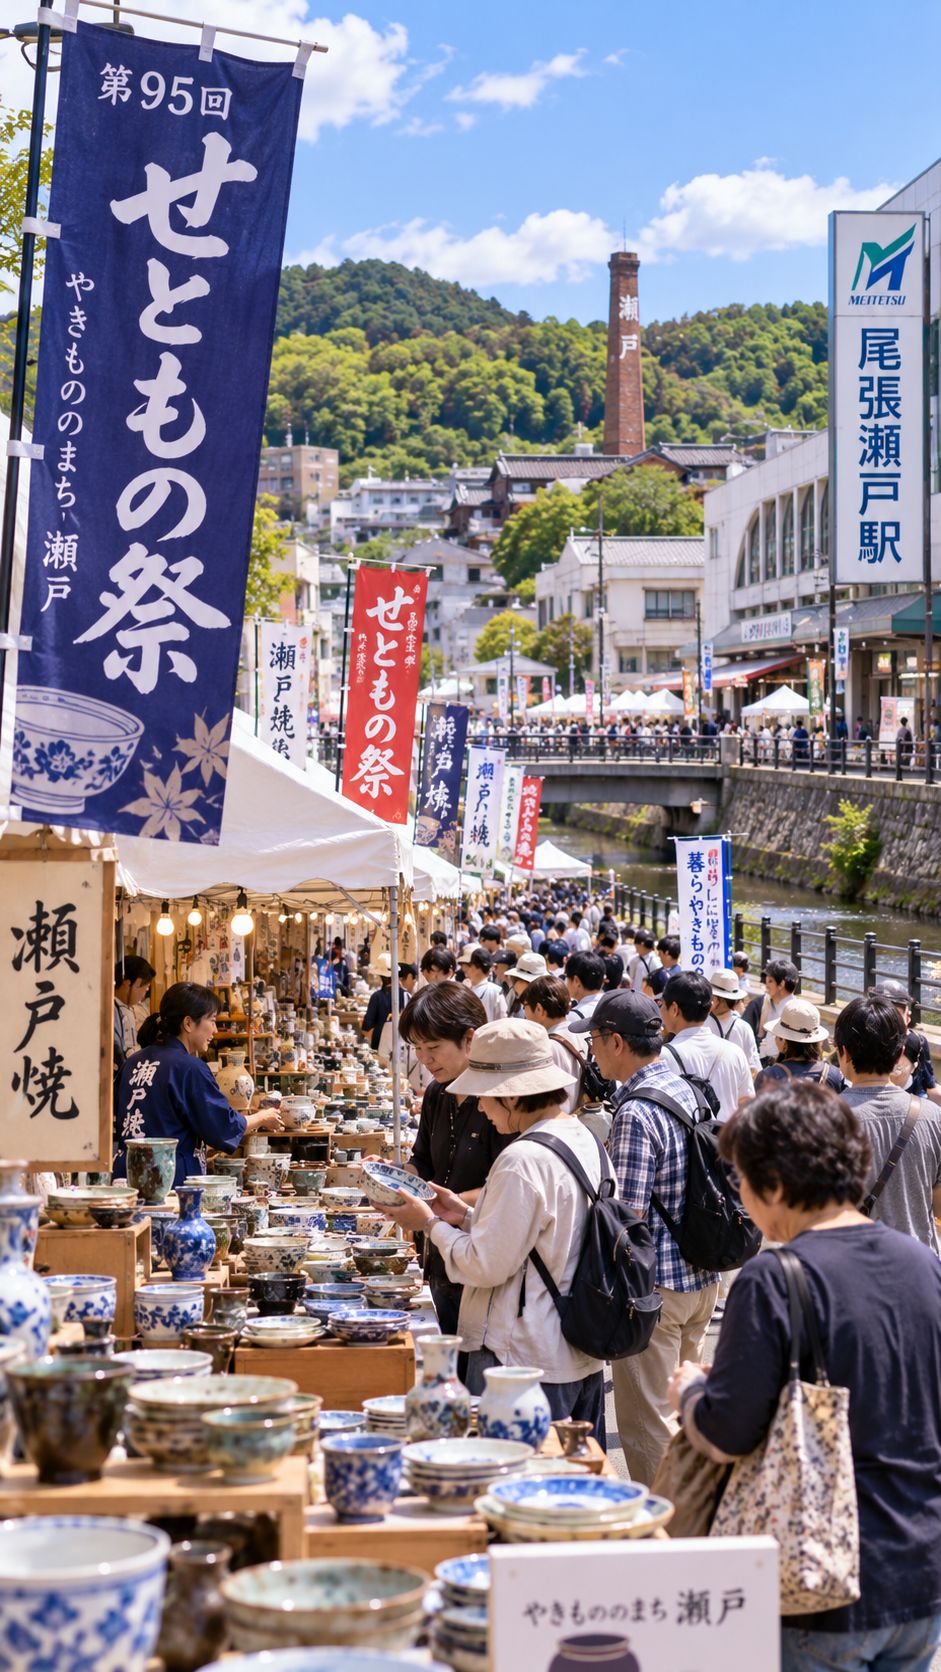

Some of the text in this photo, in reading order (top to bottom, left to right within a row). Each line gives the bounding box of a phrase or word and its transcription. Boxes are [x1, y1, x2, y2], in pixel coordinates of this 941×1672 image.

[97, 62, 233, 121] 第95回
[617, 294, 639, 360] 瀬戸
[848, 295, 906, 306] MEITETSU
[73, 131, 259, 695] せともの祭
[857, 326, 903, 565] 尾張瀬戸駅
[349, 585, 415, 799] せともの祭
[10, 899, 80, 1121] 瀬戸焼
[121, 1059, 160, 1139] 瀬戸焼
[676, 1587, 747, 1627] 瀬戸
